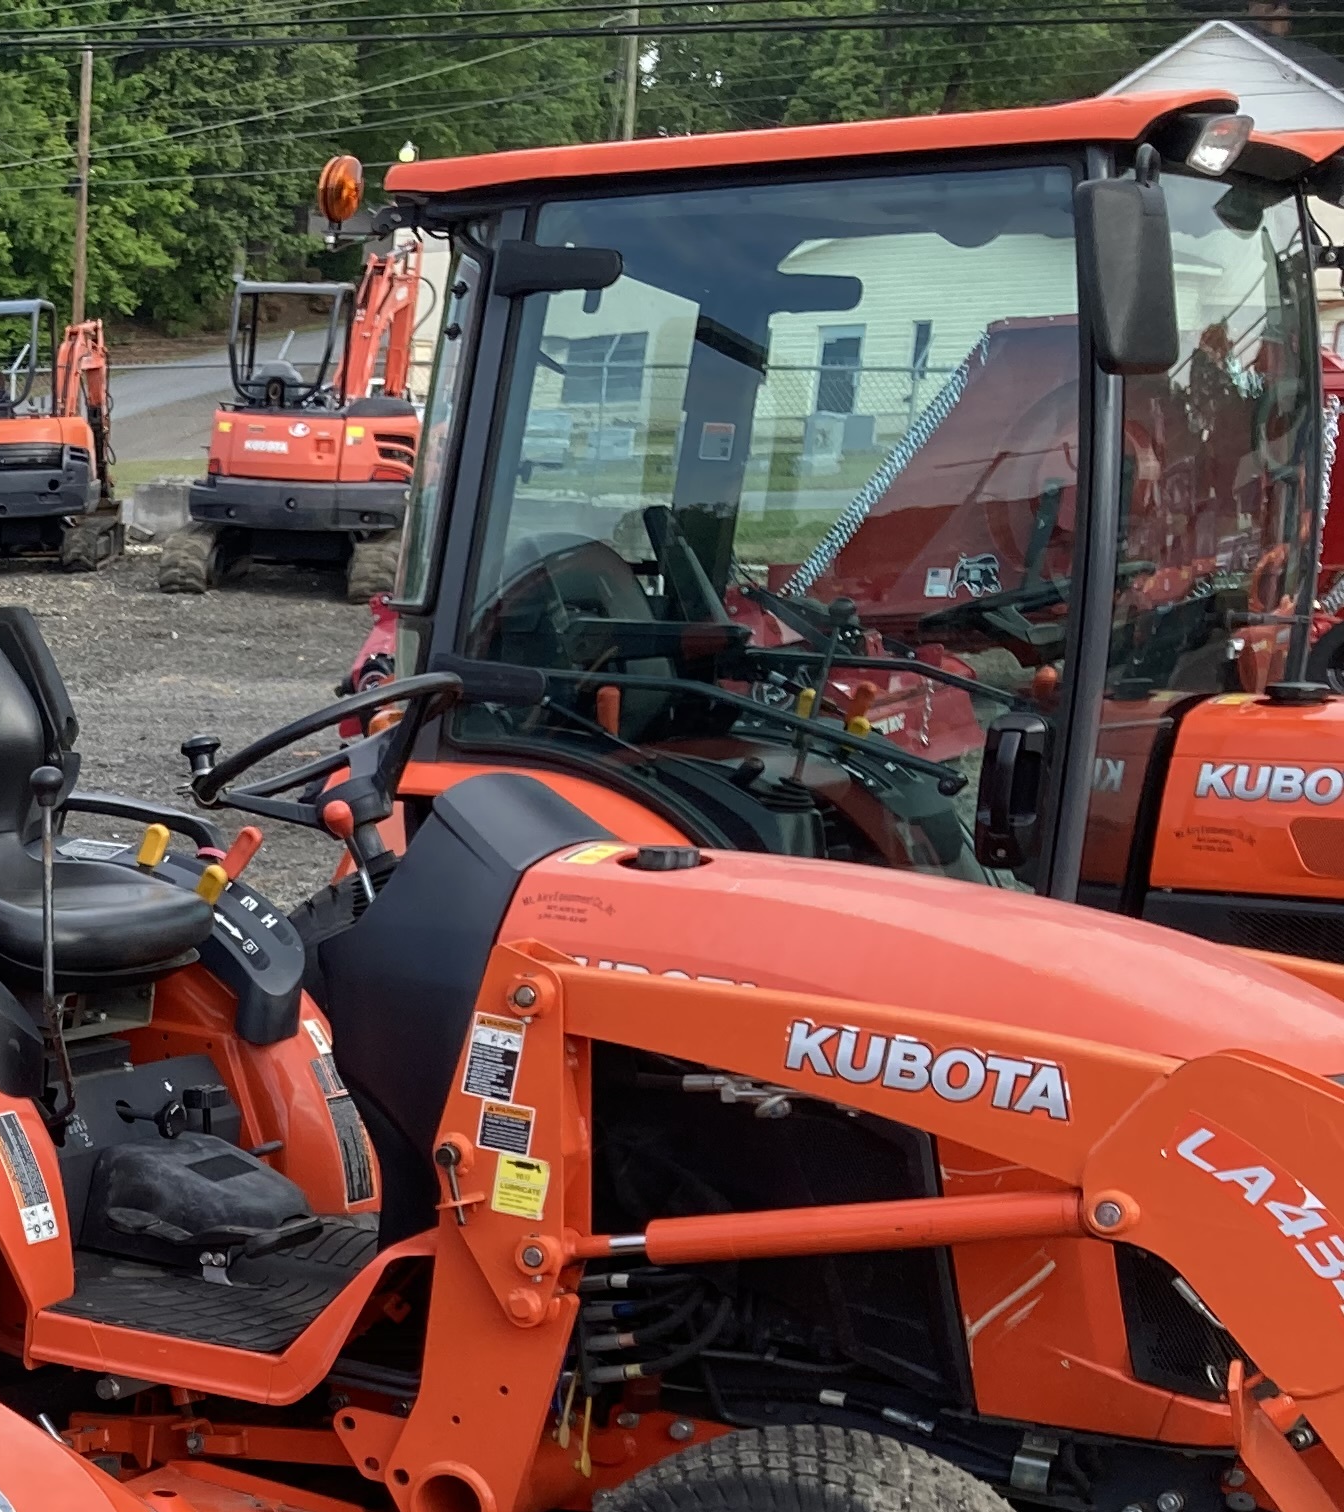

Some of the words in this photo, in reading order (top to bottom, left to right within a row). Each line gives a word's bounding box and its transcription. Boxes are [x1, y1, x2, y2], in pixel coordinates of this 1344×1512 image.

[1195, 761, 1344, 805] KUBO
[785, 1018, 1070, 1123] KUBOTA
[1176, 1127, 1344, 1315] LA43
